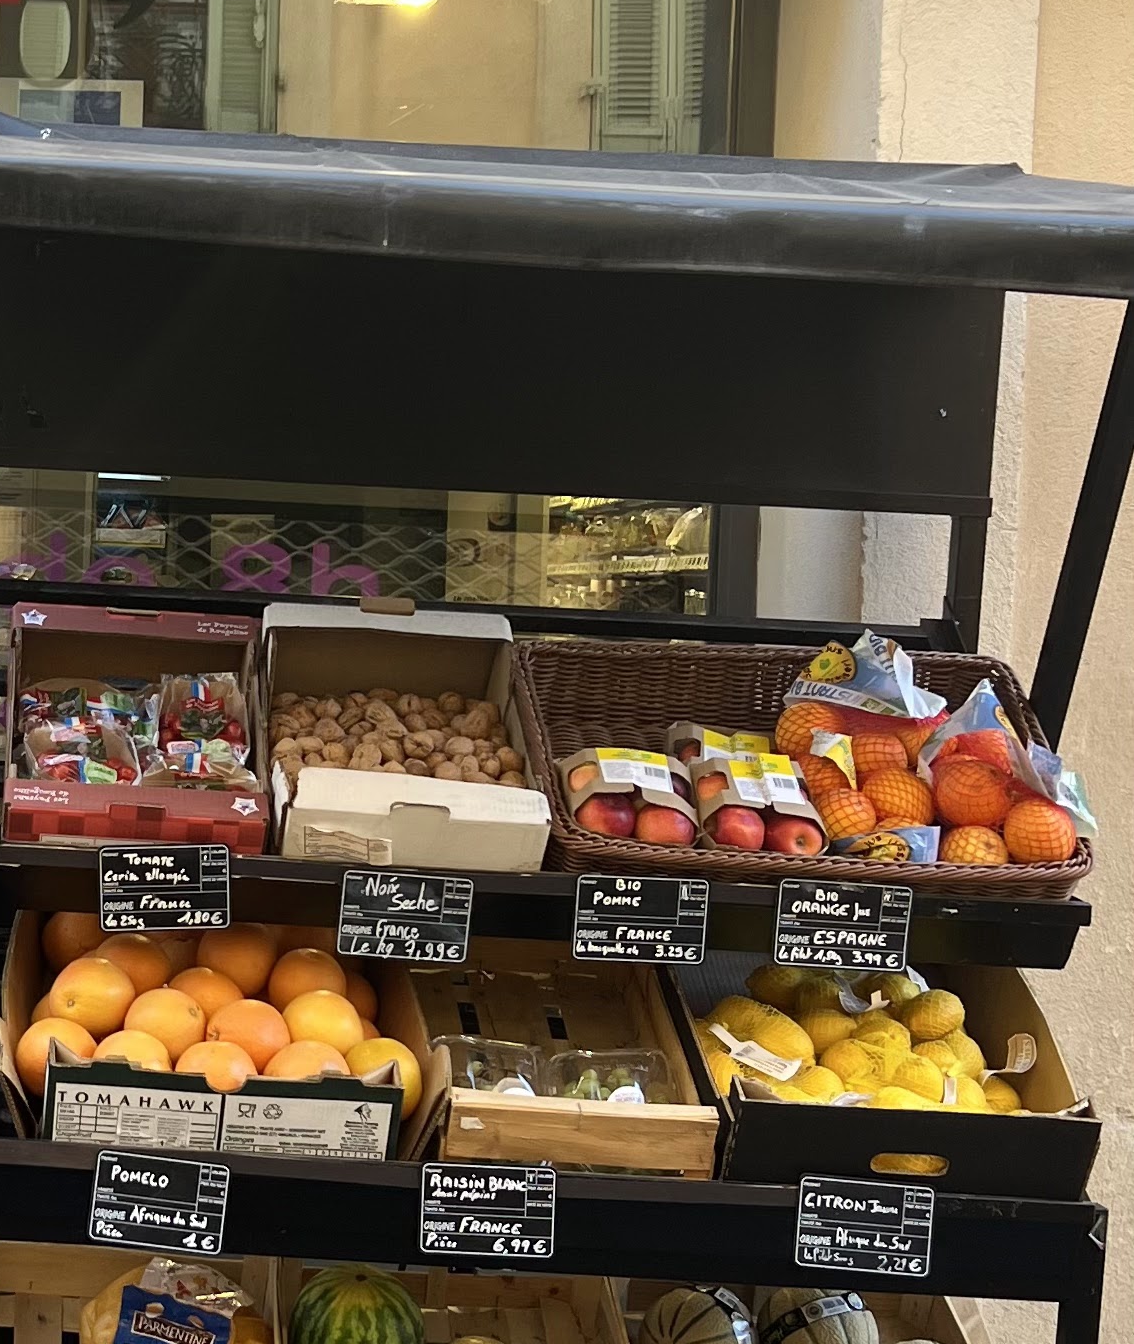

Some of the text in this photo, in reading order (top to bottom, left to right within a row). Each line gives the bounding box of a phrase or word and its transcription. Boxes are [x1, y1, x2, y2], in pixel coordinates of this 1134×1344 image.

[123, 853, 174, 867] TOMATE
[616, 878, 641, 891] BIO
[593, 891, 641, 906] POMME
[815, 889, 839, 902] BIO
[791, 900, 850, 916] ORANGE
[853, 902, 870, 921] Jus
[616, 926, 672, 941] FRANCE
[813, 930, 887, 947] ESPAGNE
[350, 936, 370, 954] Le
[57, 1091, 214, 1113] TOMAHAWK
[111, 1164, 169, 1188] POMELO
[488, 1176, 528, 1192] BLANC
[804, 1192, 866, 1211] CITRON
[459, 1217, 522, 1235] FRANCE
